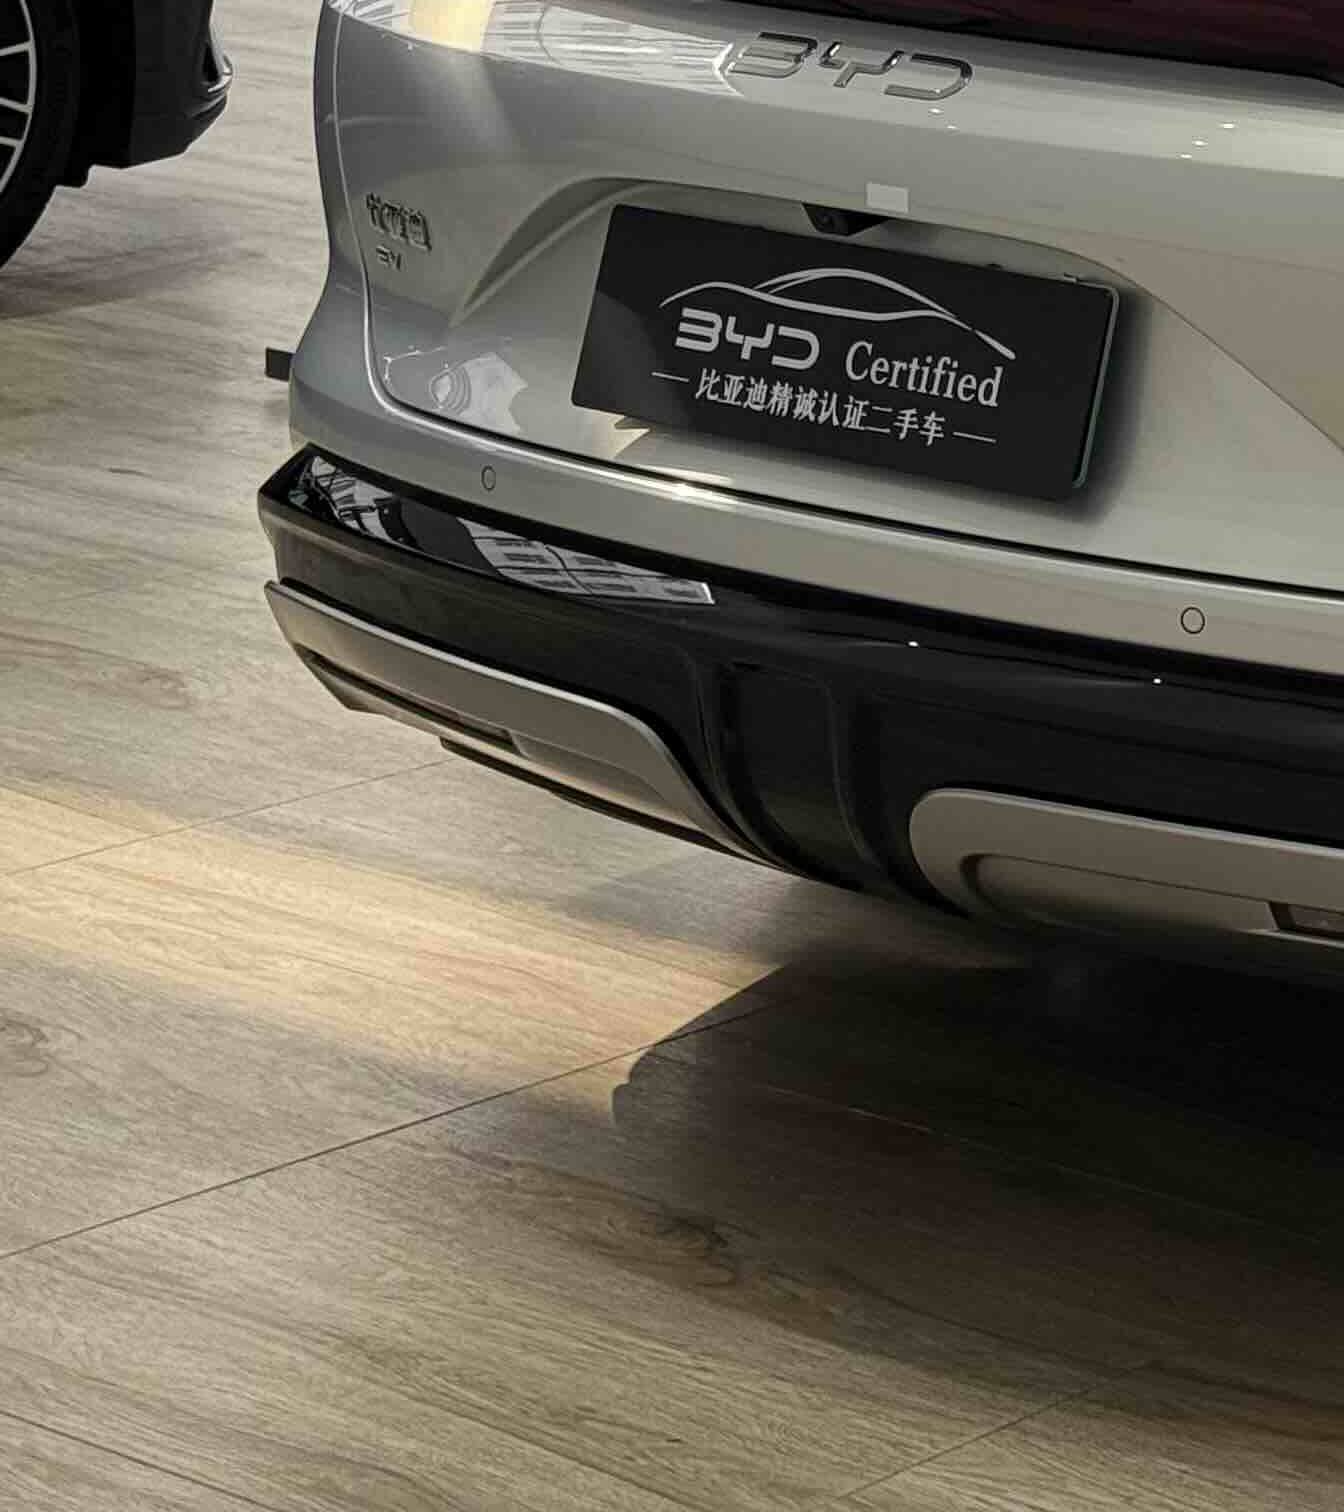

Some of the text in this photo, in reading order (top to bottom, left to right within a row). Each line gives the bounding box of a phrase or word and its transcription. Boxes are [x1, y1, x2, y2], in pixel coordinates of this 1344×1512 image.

[725, 31, 974, 101] BYD
[674, 307, 1003, 407] BYD Certified
[695, 367, 945, 446] 比亚迪精诚认证二手车
